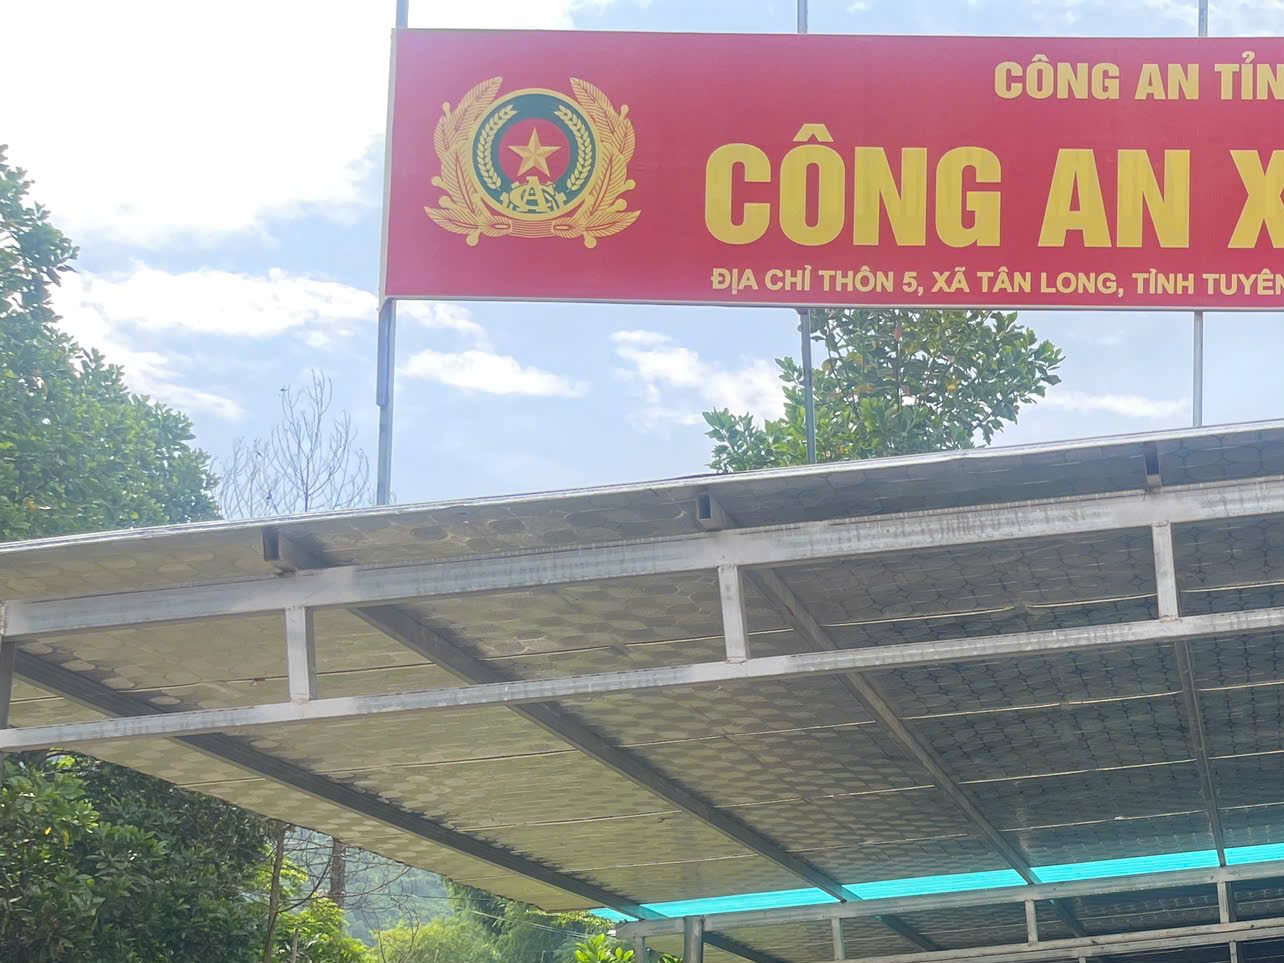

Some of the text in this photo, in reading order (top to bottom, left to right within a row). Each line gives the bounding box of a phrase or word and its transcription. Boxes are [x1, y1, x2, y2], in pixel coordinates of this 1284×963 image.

[995, 53, 1120, 100] CÔNG
[1134, 63, 1200, 100] AN
[704, 123, 1002, 248] CÔNG
[1037, 148, 1191, 249] AN
[710, 267, 759, 295] ĐỊA
[764, 264, 812, 291] CHỈ
[818, 265, 894, 293] THÔN
[902, 271, 924, 297] 5,
[931, 266, 970, 293] XÃ
[976, 266, 1032, 293] TÂN
[1040, 271, 1124, 298] LONG,
[1131, 268, 1195, 295] TỈNH
